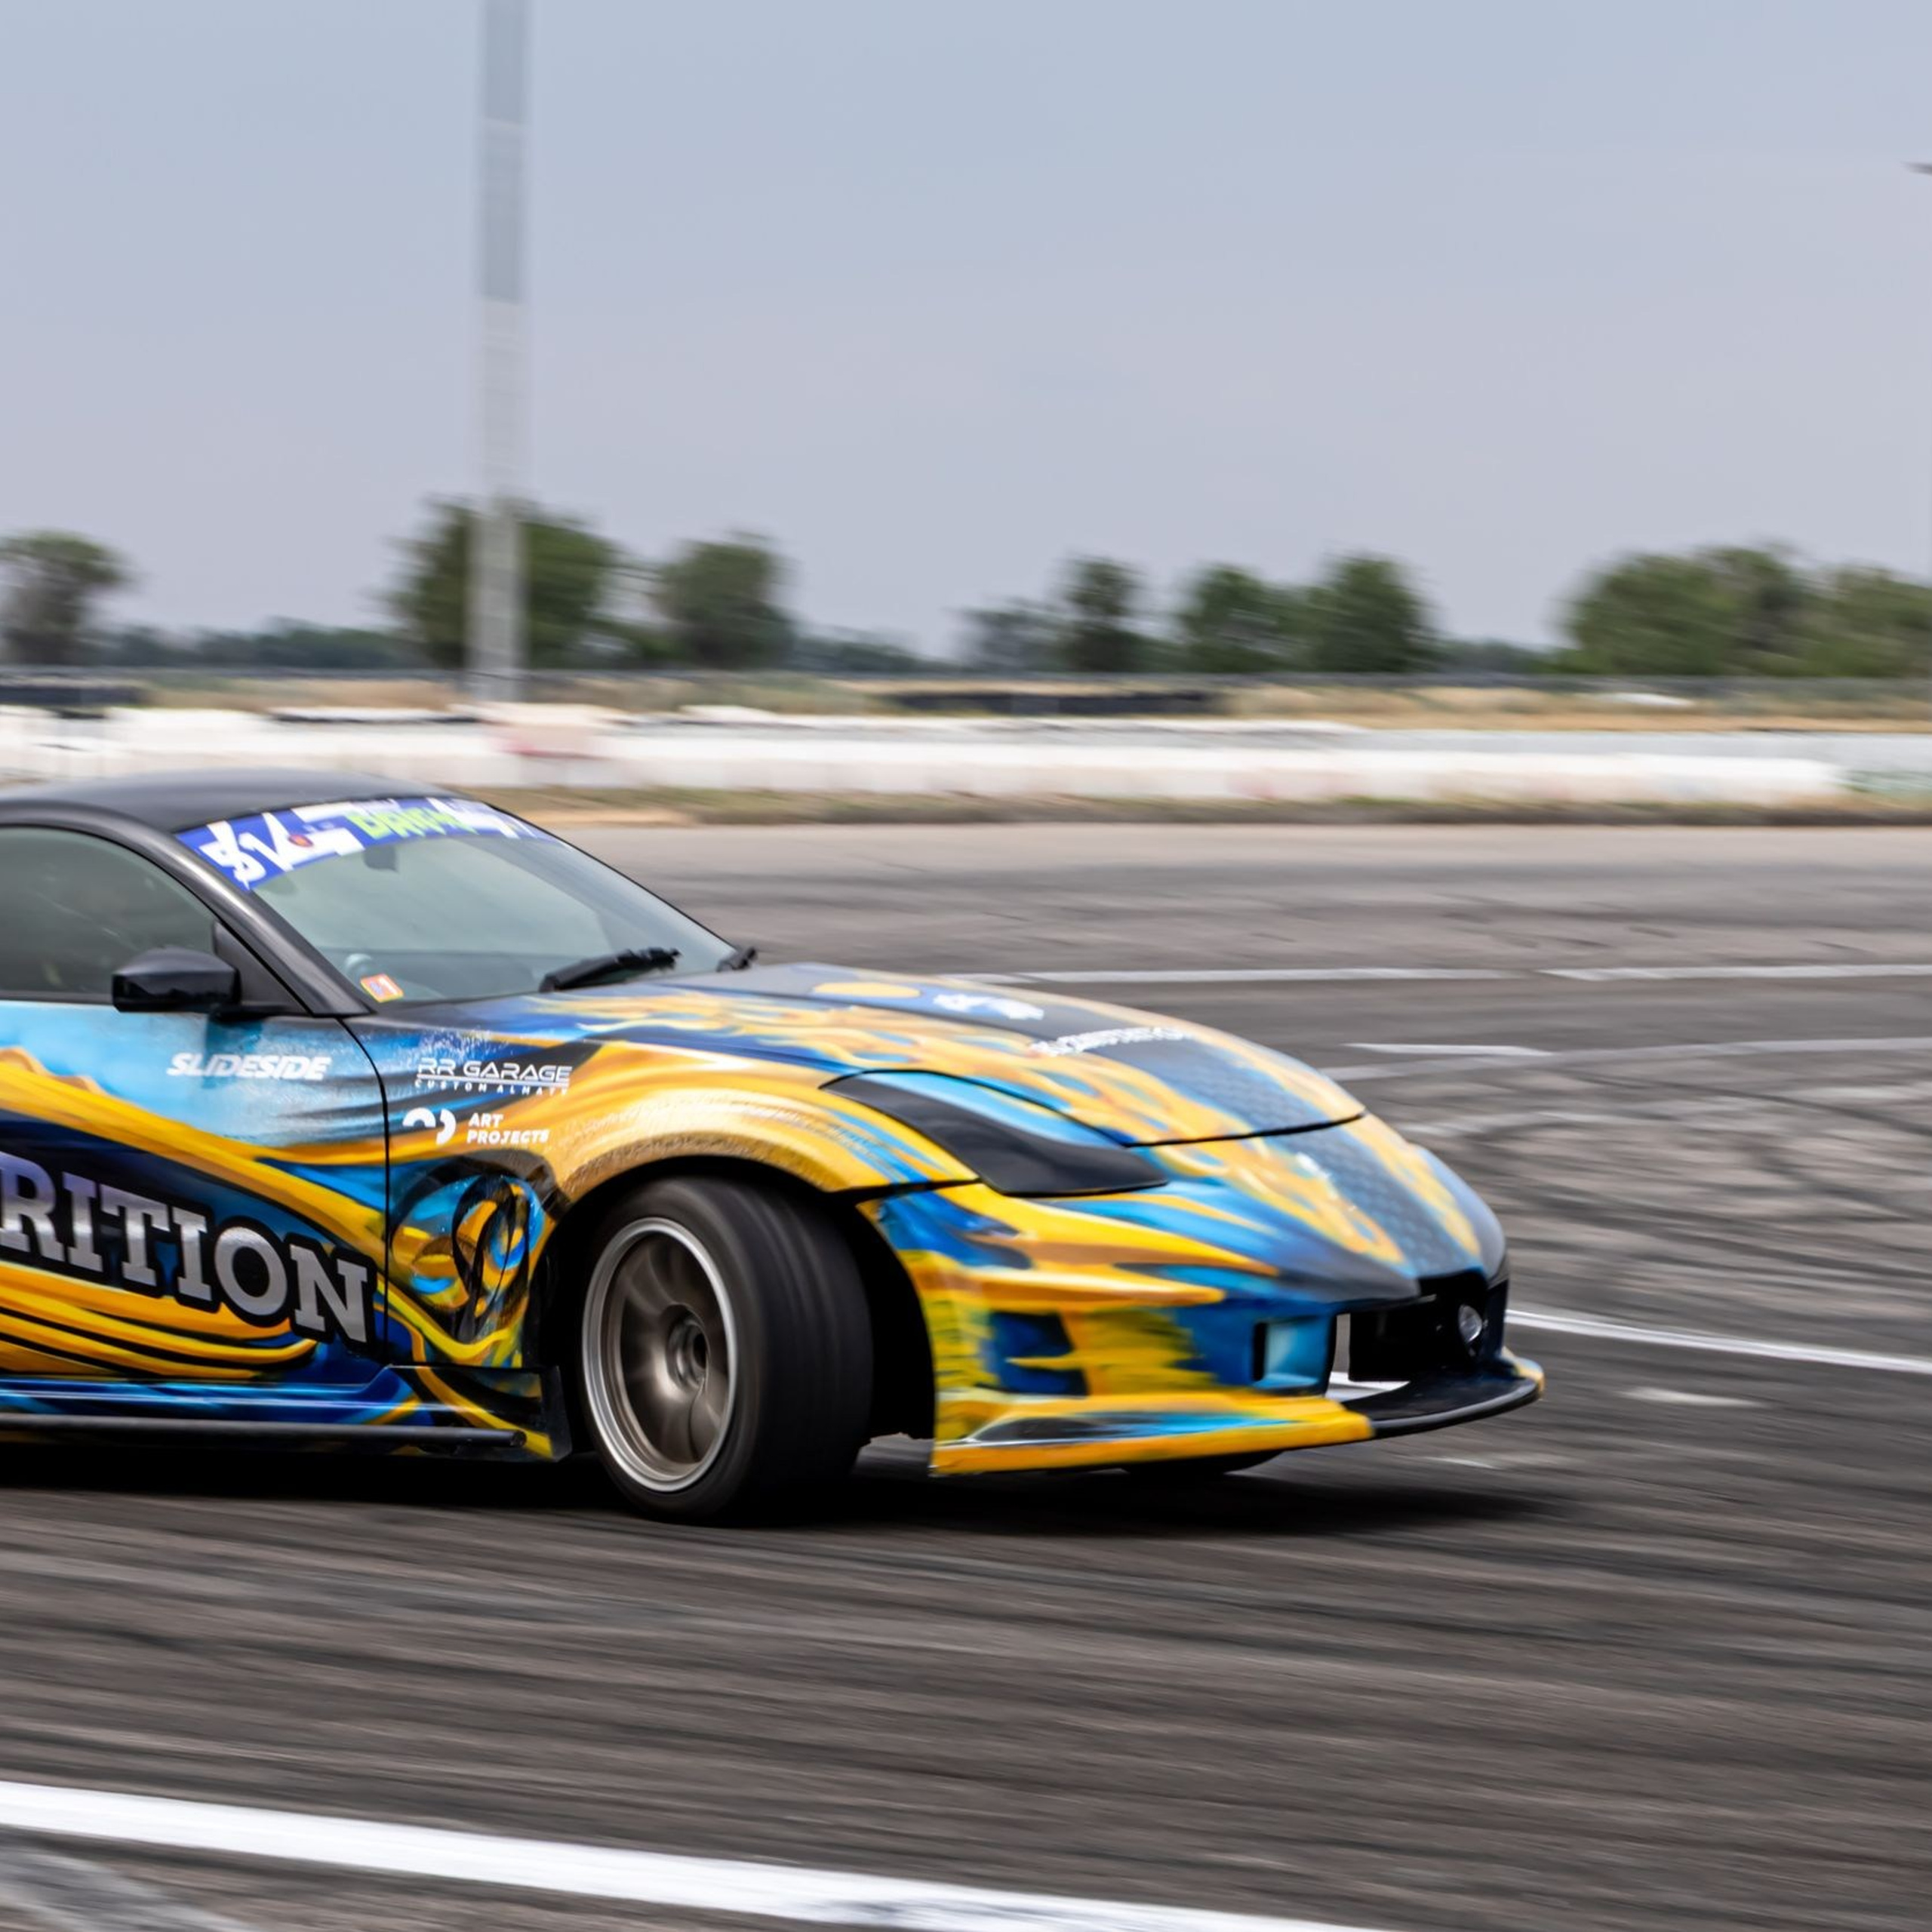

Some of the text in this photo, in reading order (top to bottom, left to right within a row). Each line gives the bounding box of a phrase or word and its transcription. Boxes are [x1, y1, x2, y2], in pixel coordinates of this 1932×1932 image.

[166, 1053, 332, 1081] SLIDESIDE
[417, 1057, 572, 1082] RR GARAGE
[415, 1078, 487, 1092] CUSTOM
[466, 1113, 549, 1144] ART PROJECTS
